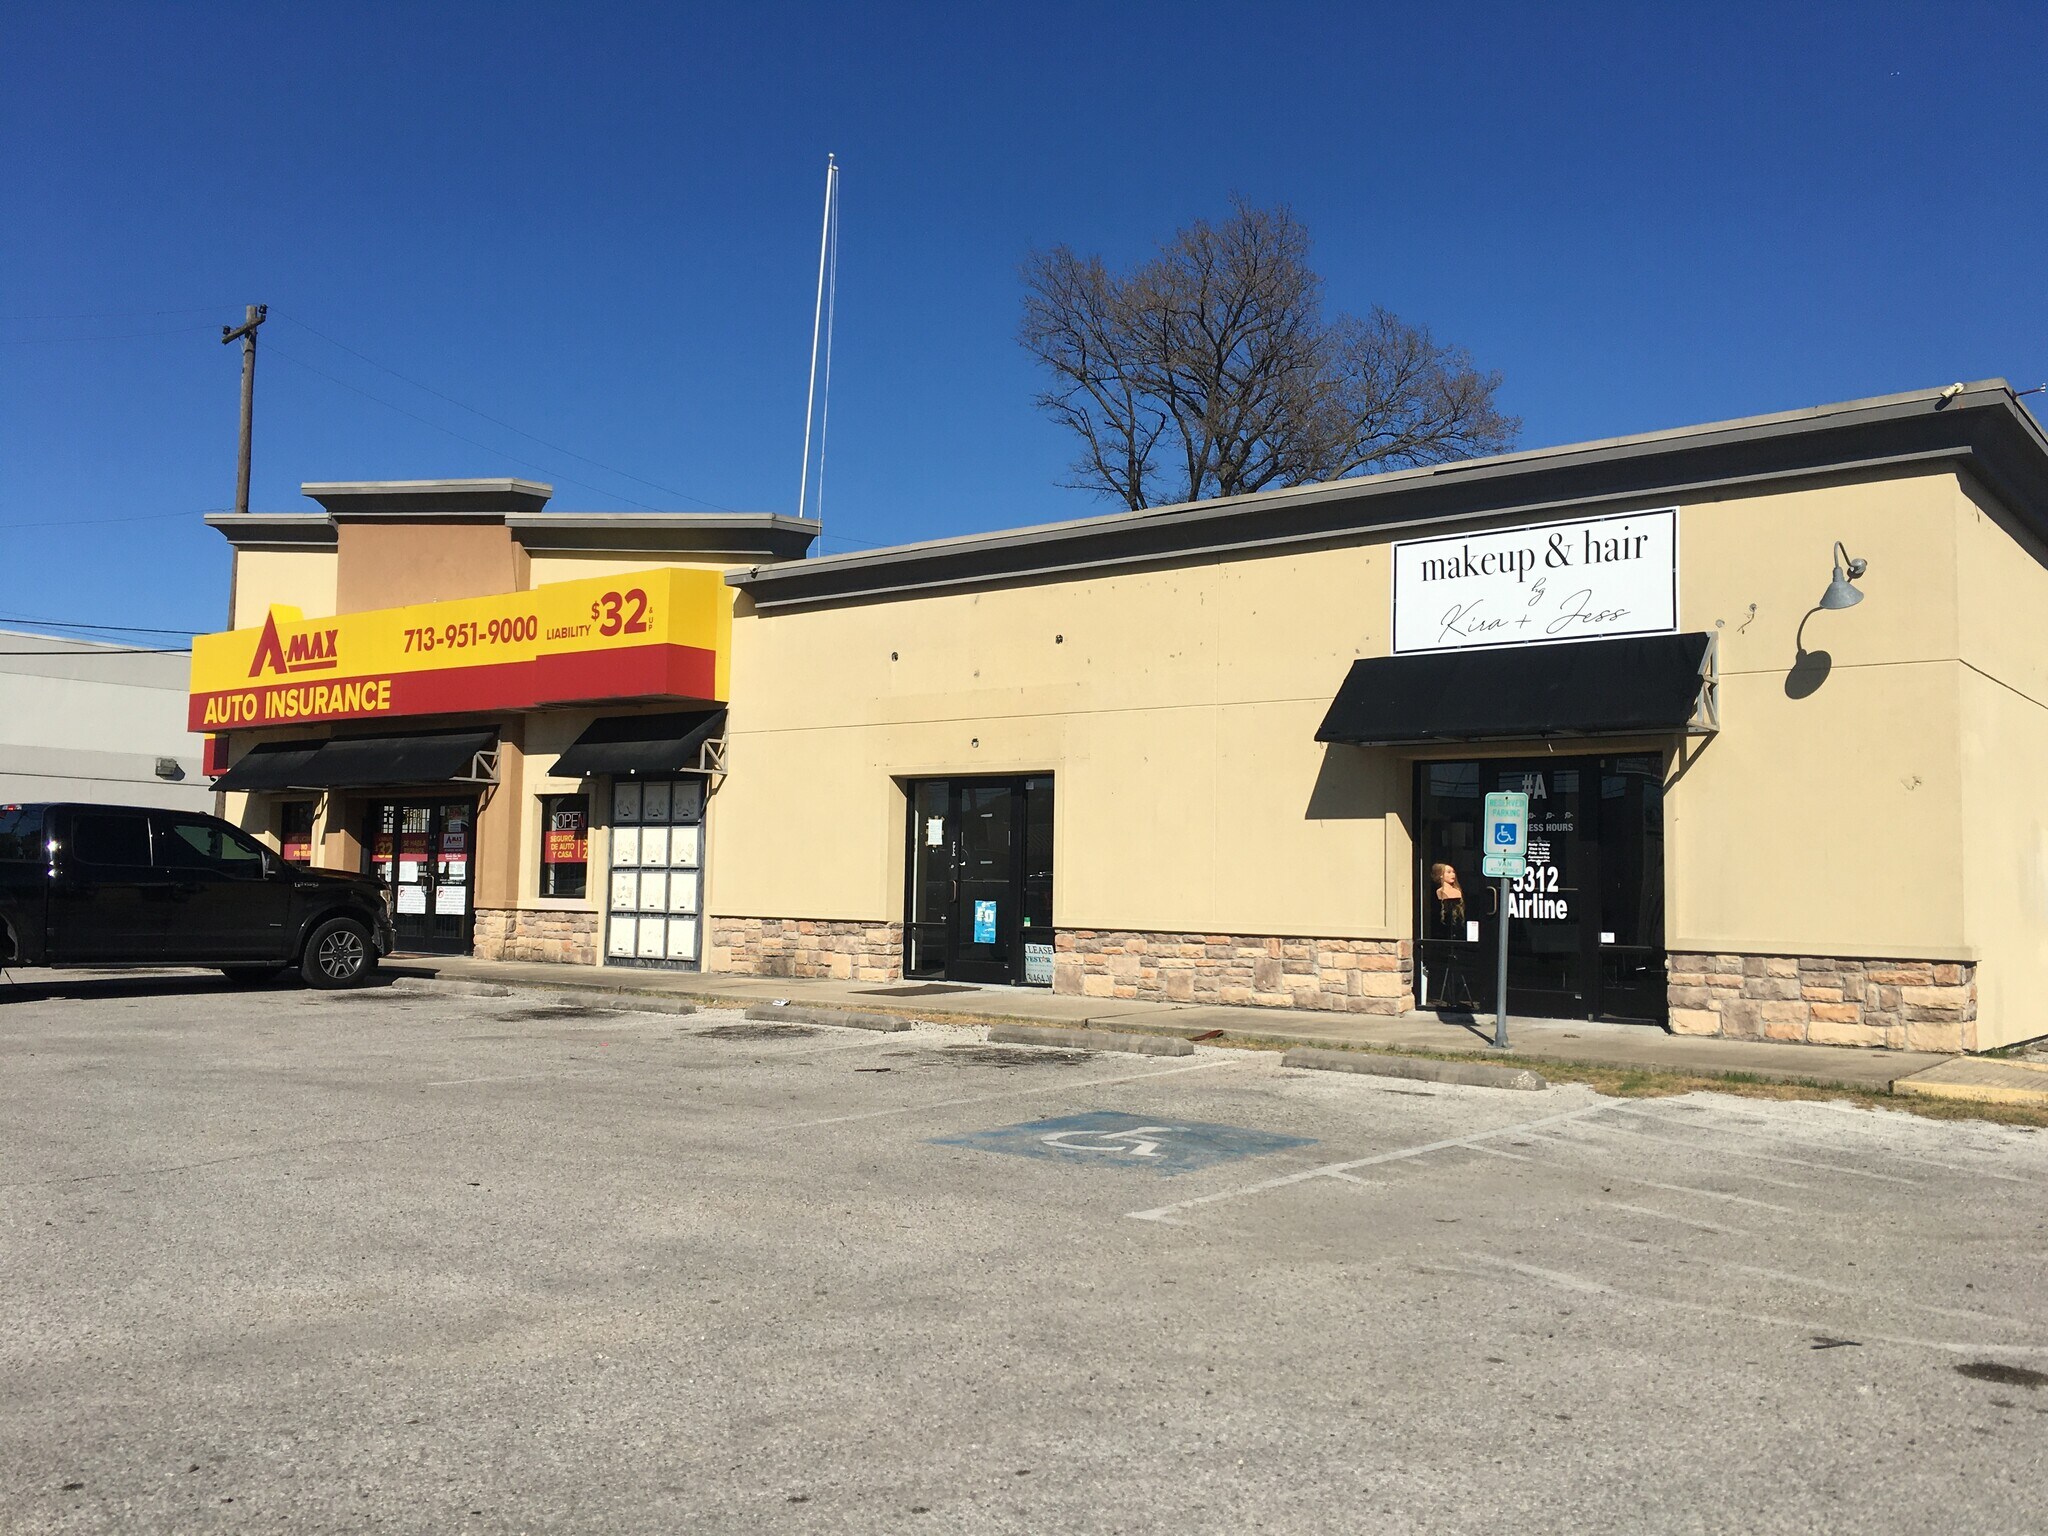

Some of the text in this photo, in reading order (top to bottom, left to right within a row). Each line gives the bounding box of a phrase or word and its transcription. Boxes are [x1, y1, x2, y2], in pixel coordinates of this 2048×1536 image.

[1420, 525, 1649, 583] makeup & hair
[1528, 577, 1547, 606] by
[1438, 588, 1631, 643] Kira + Jess
[403, 614, 539, 653] 713-951-9000
[546, 624, 592, 640] LIABILITY
[203, 680, 392, 724] AUTO INSURANCE
[557, 813, 584, 828] OPEN
[1492, 808, 1520, 817] PARKING
[1546, 823, 1574, 831] HOURS
[1507, 893, 1568, 919] Airline
[1028, 946, 1053, 954] LEASE
